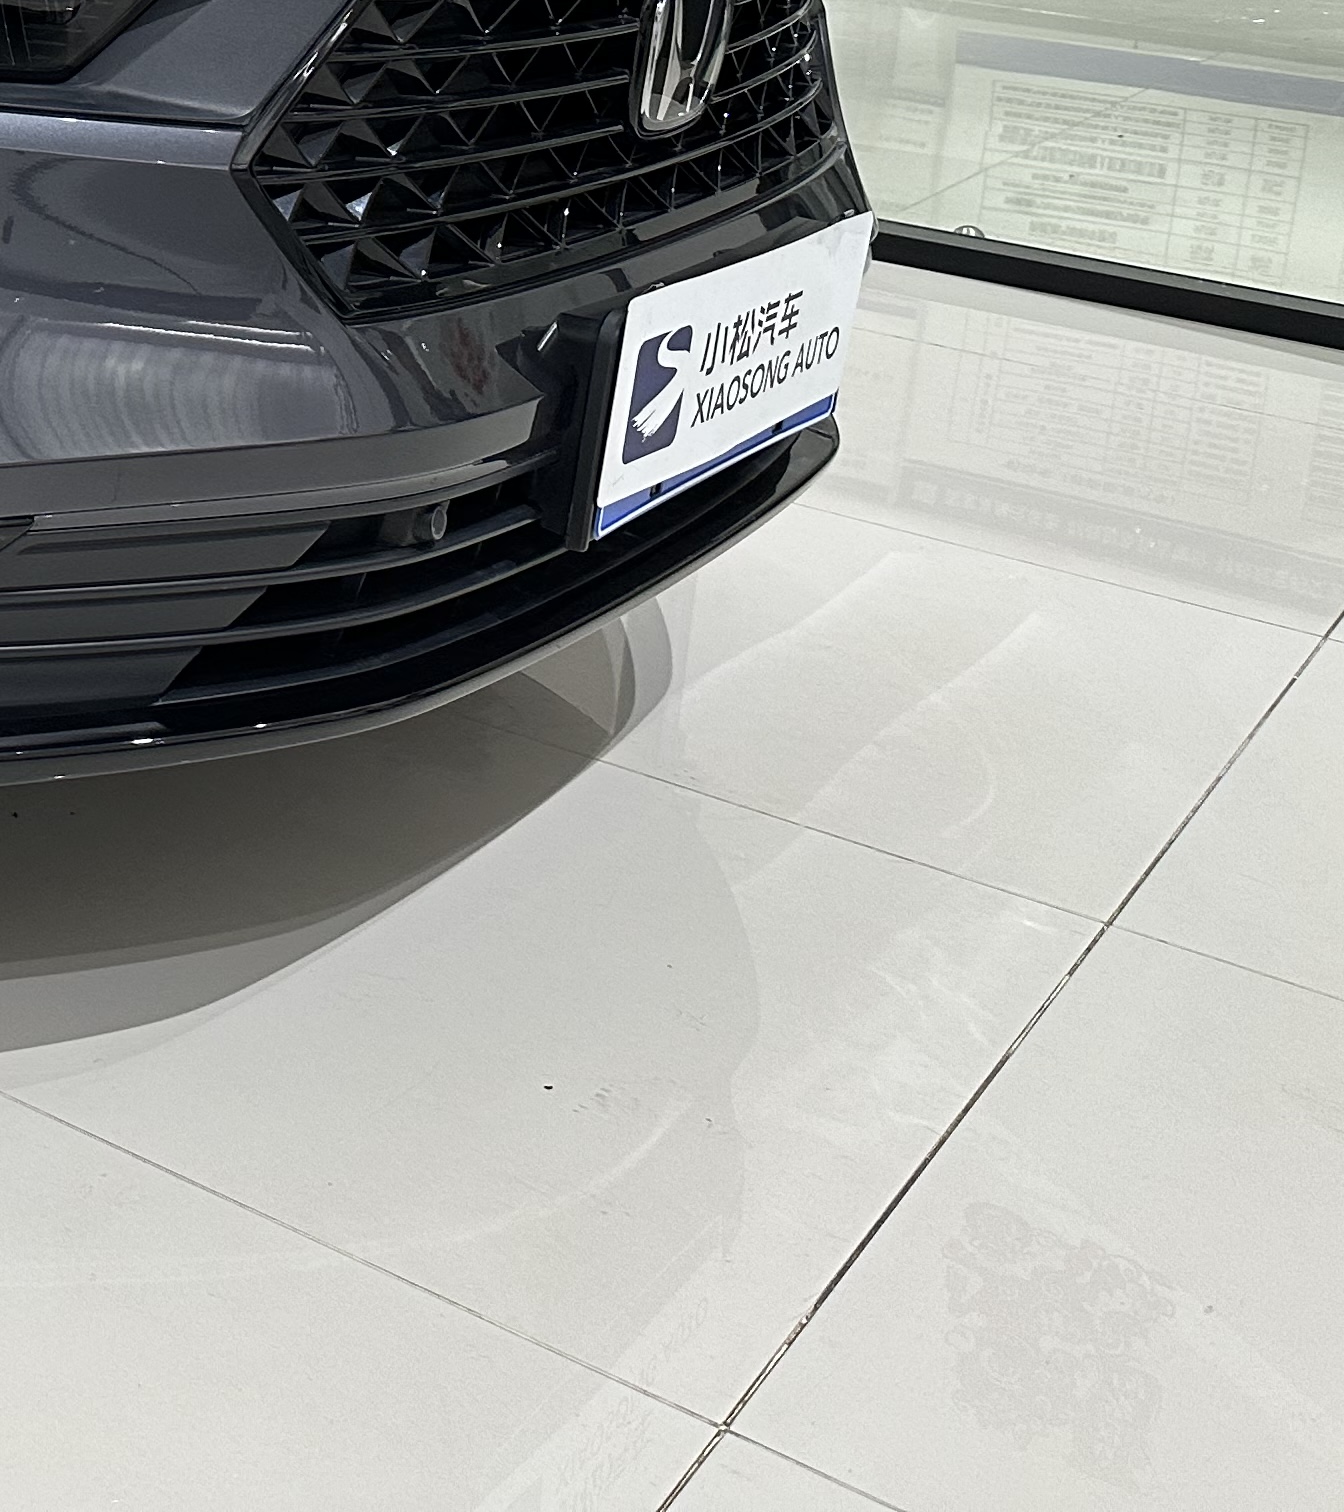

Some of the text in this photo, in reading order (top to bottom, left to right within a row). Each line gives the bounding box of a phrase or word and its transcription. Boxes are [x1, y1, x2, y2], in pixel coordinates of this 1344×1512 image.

[691, 326, 840, 428] XIAOSONG AUTO
[699, 290, 804, 376] 小松汽车
